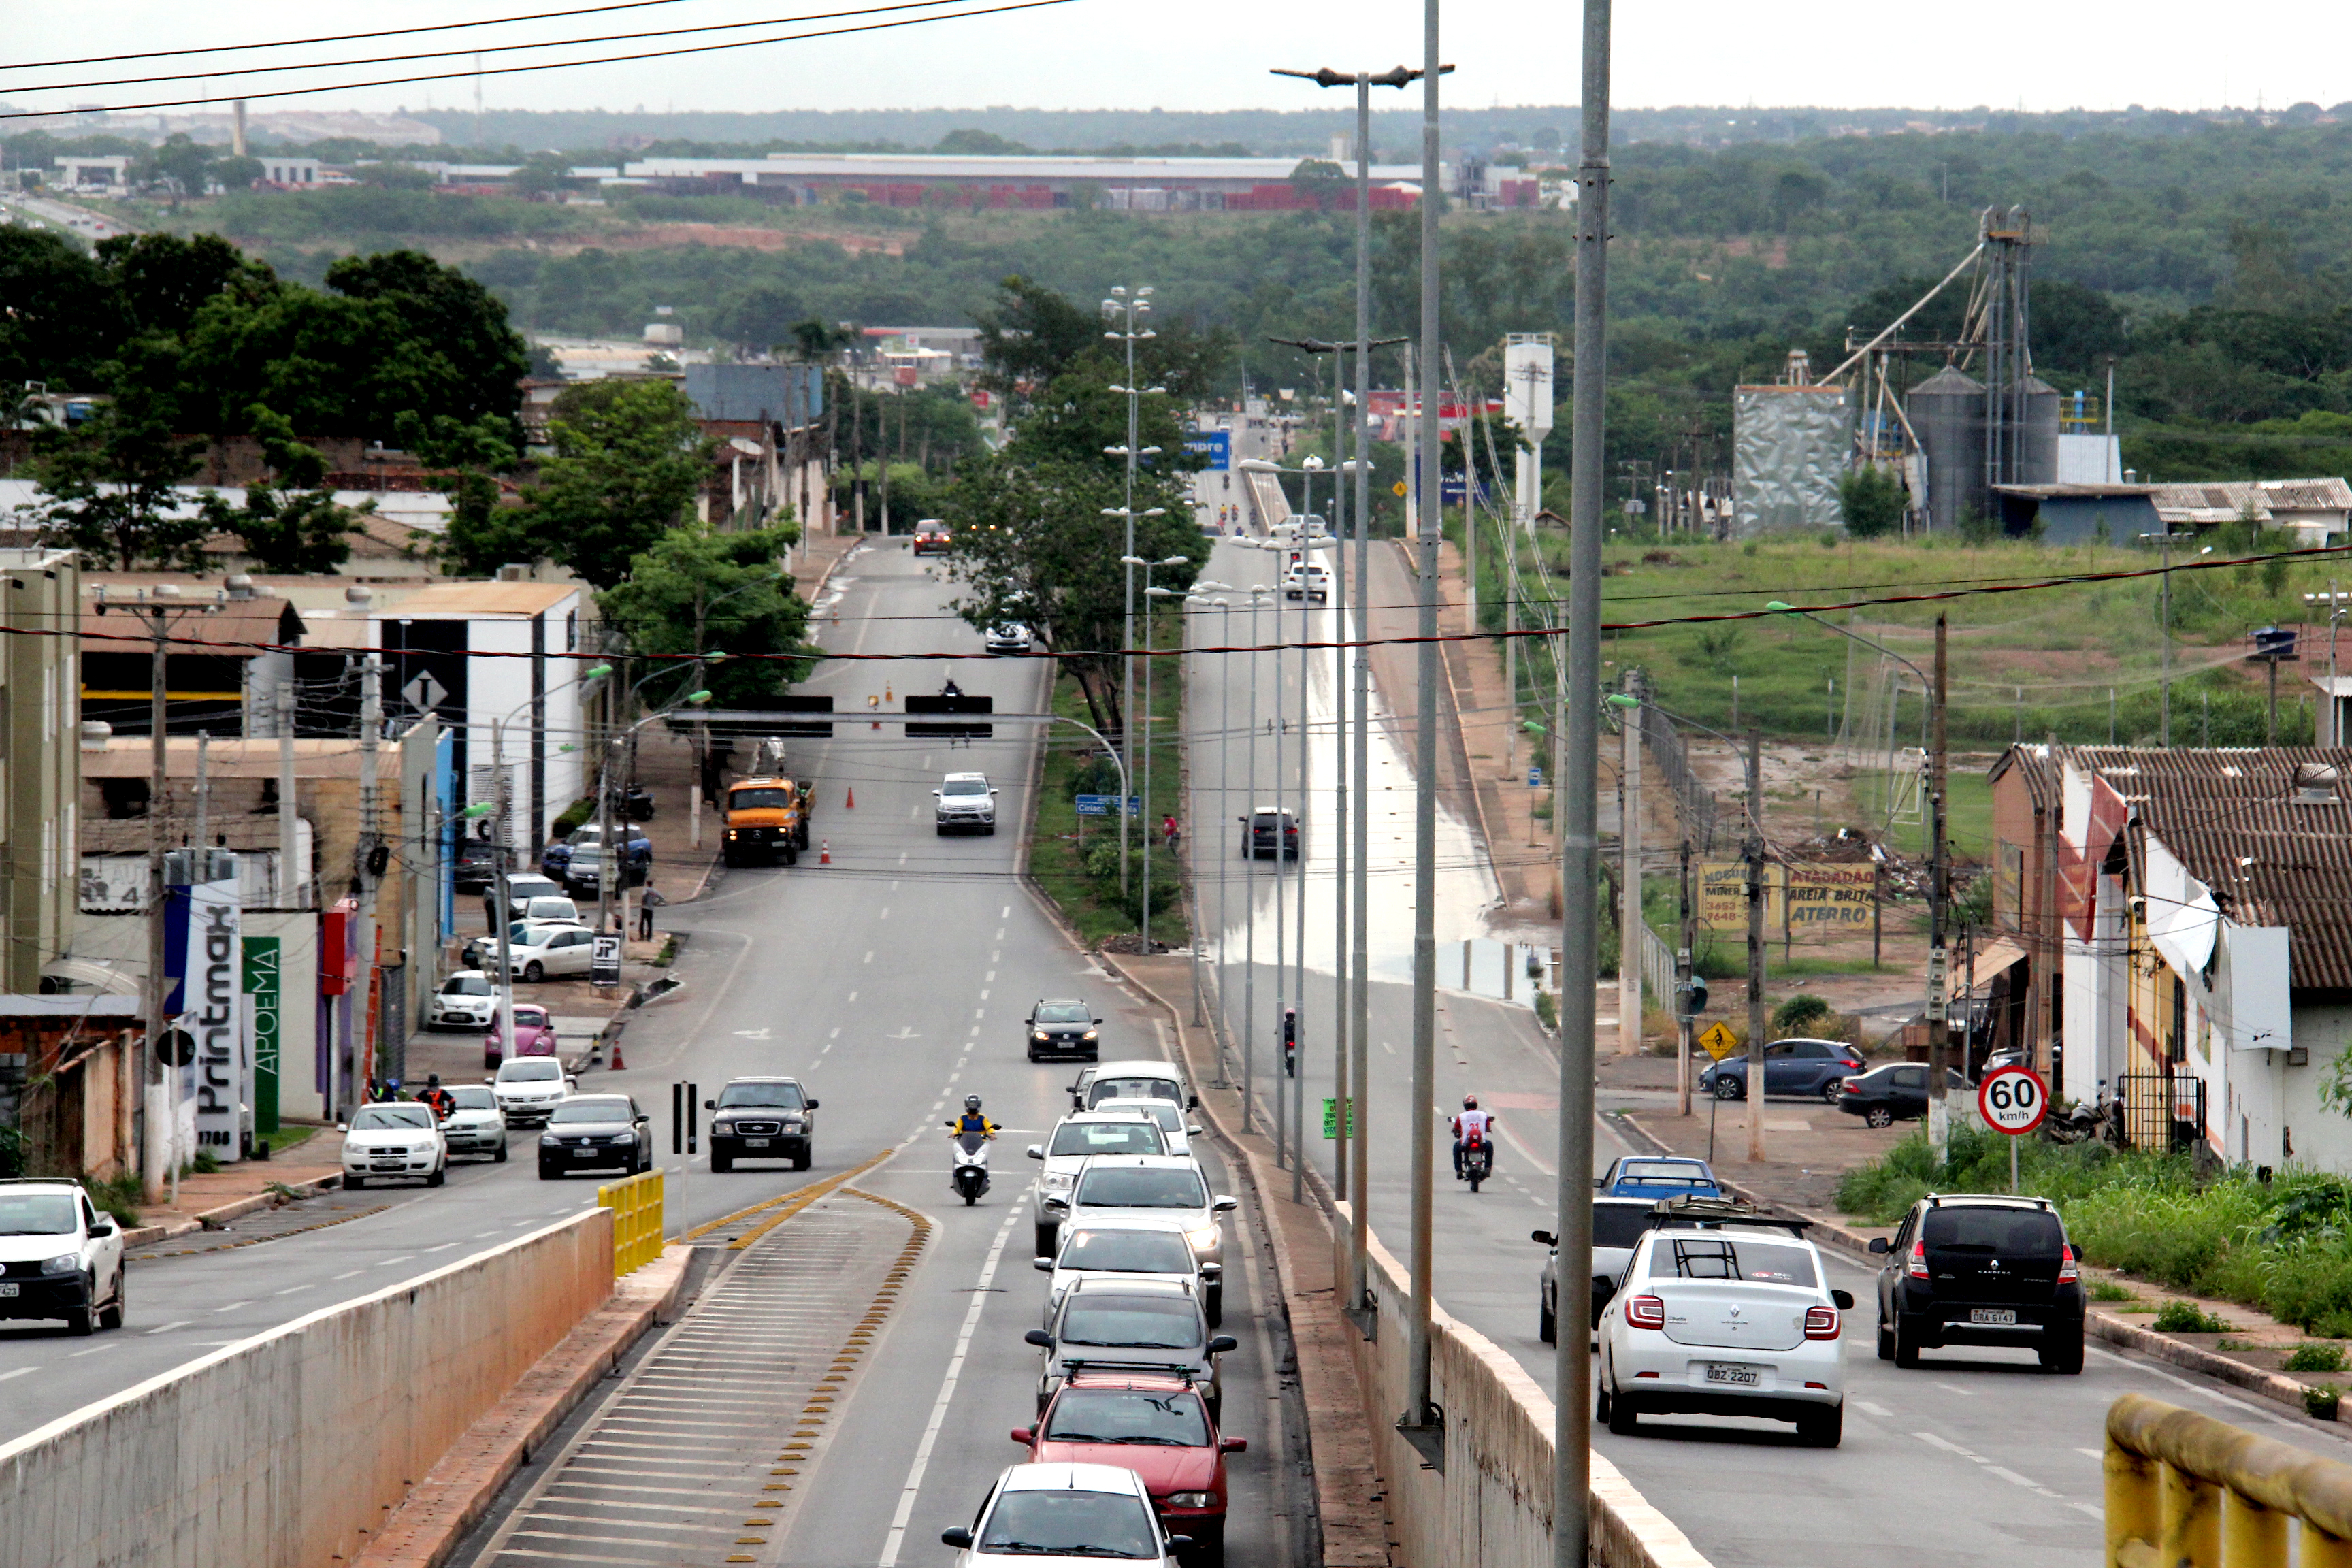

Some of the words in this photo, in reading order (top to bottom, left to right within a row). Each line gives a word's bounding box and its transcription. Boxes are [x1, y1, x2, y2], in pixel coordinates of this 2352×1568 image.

[1789, 889, 1827, 901] AREIA
[1833, 889, 1874, 902] BRITA
[1791, 906, 1866, 922] ATERRO
[197, 905, 231, 1115] Printmax
[252, 949, 278, 1075] APOEMA
[1991, 1079, 2035, 1109] 60
[1999, 1111, 2029, 1120] km/h
